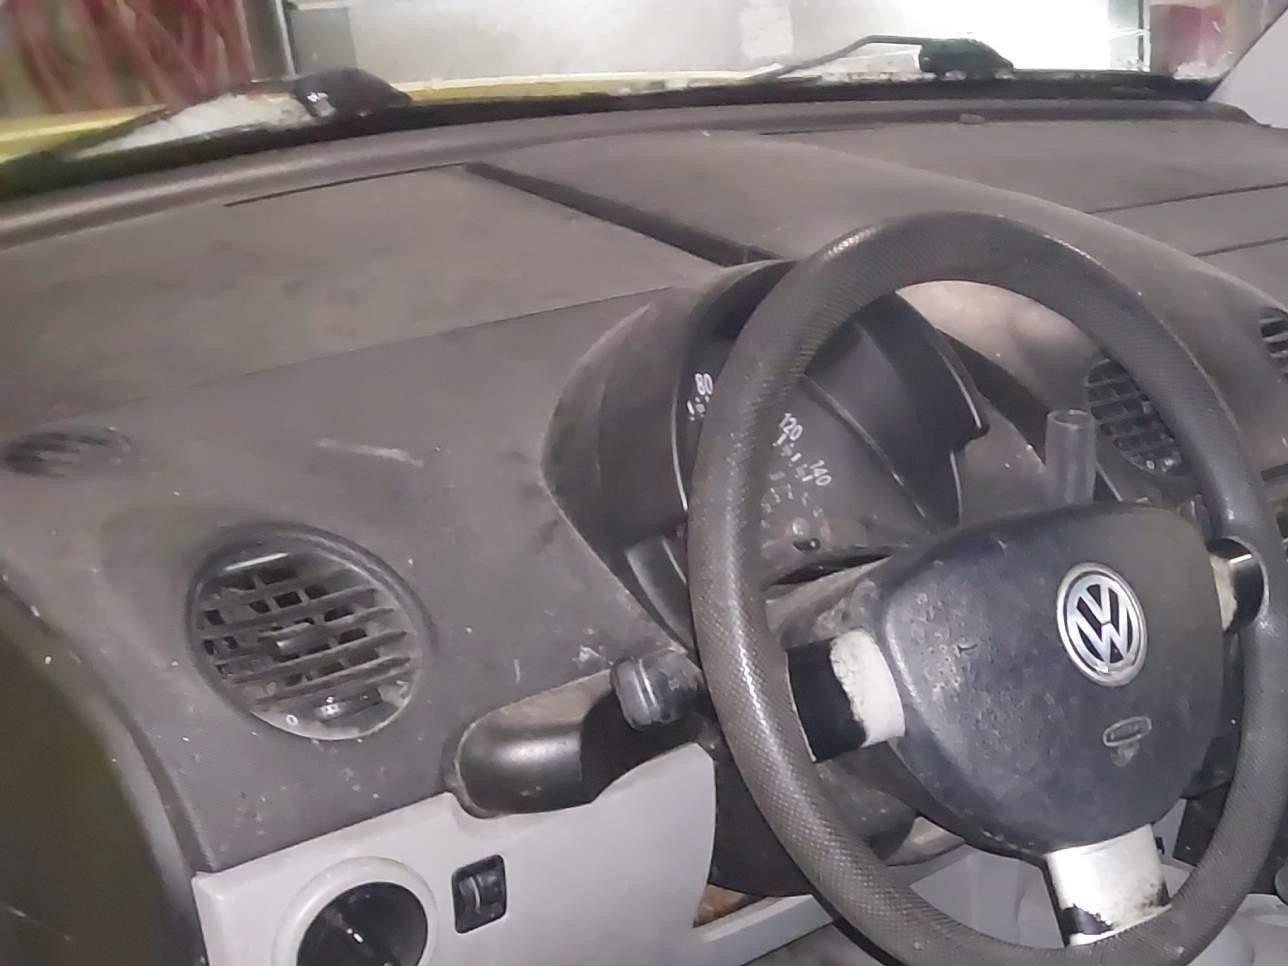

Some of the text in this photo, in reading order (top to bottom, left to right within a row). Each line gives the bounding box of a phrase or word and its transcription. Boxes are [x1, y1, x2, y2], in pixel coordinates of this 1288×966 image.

[695, 373, 713, 395] 80
[779, 412, 804, 441] 120
[809, 459, 832, 486] 140
[1063, 568, 1142, 677] VW
